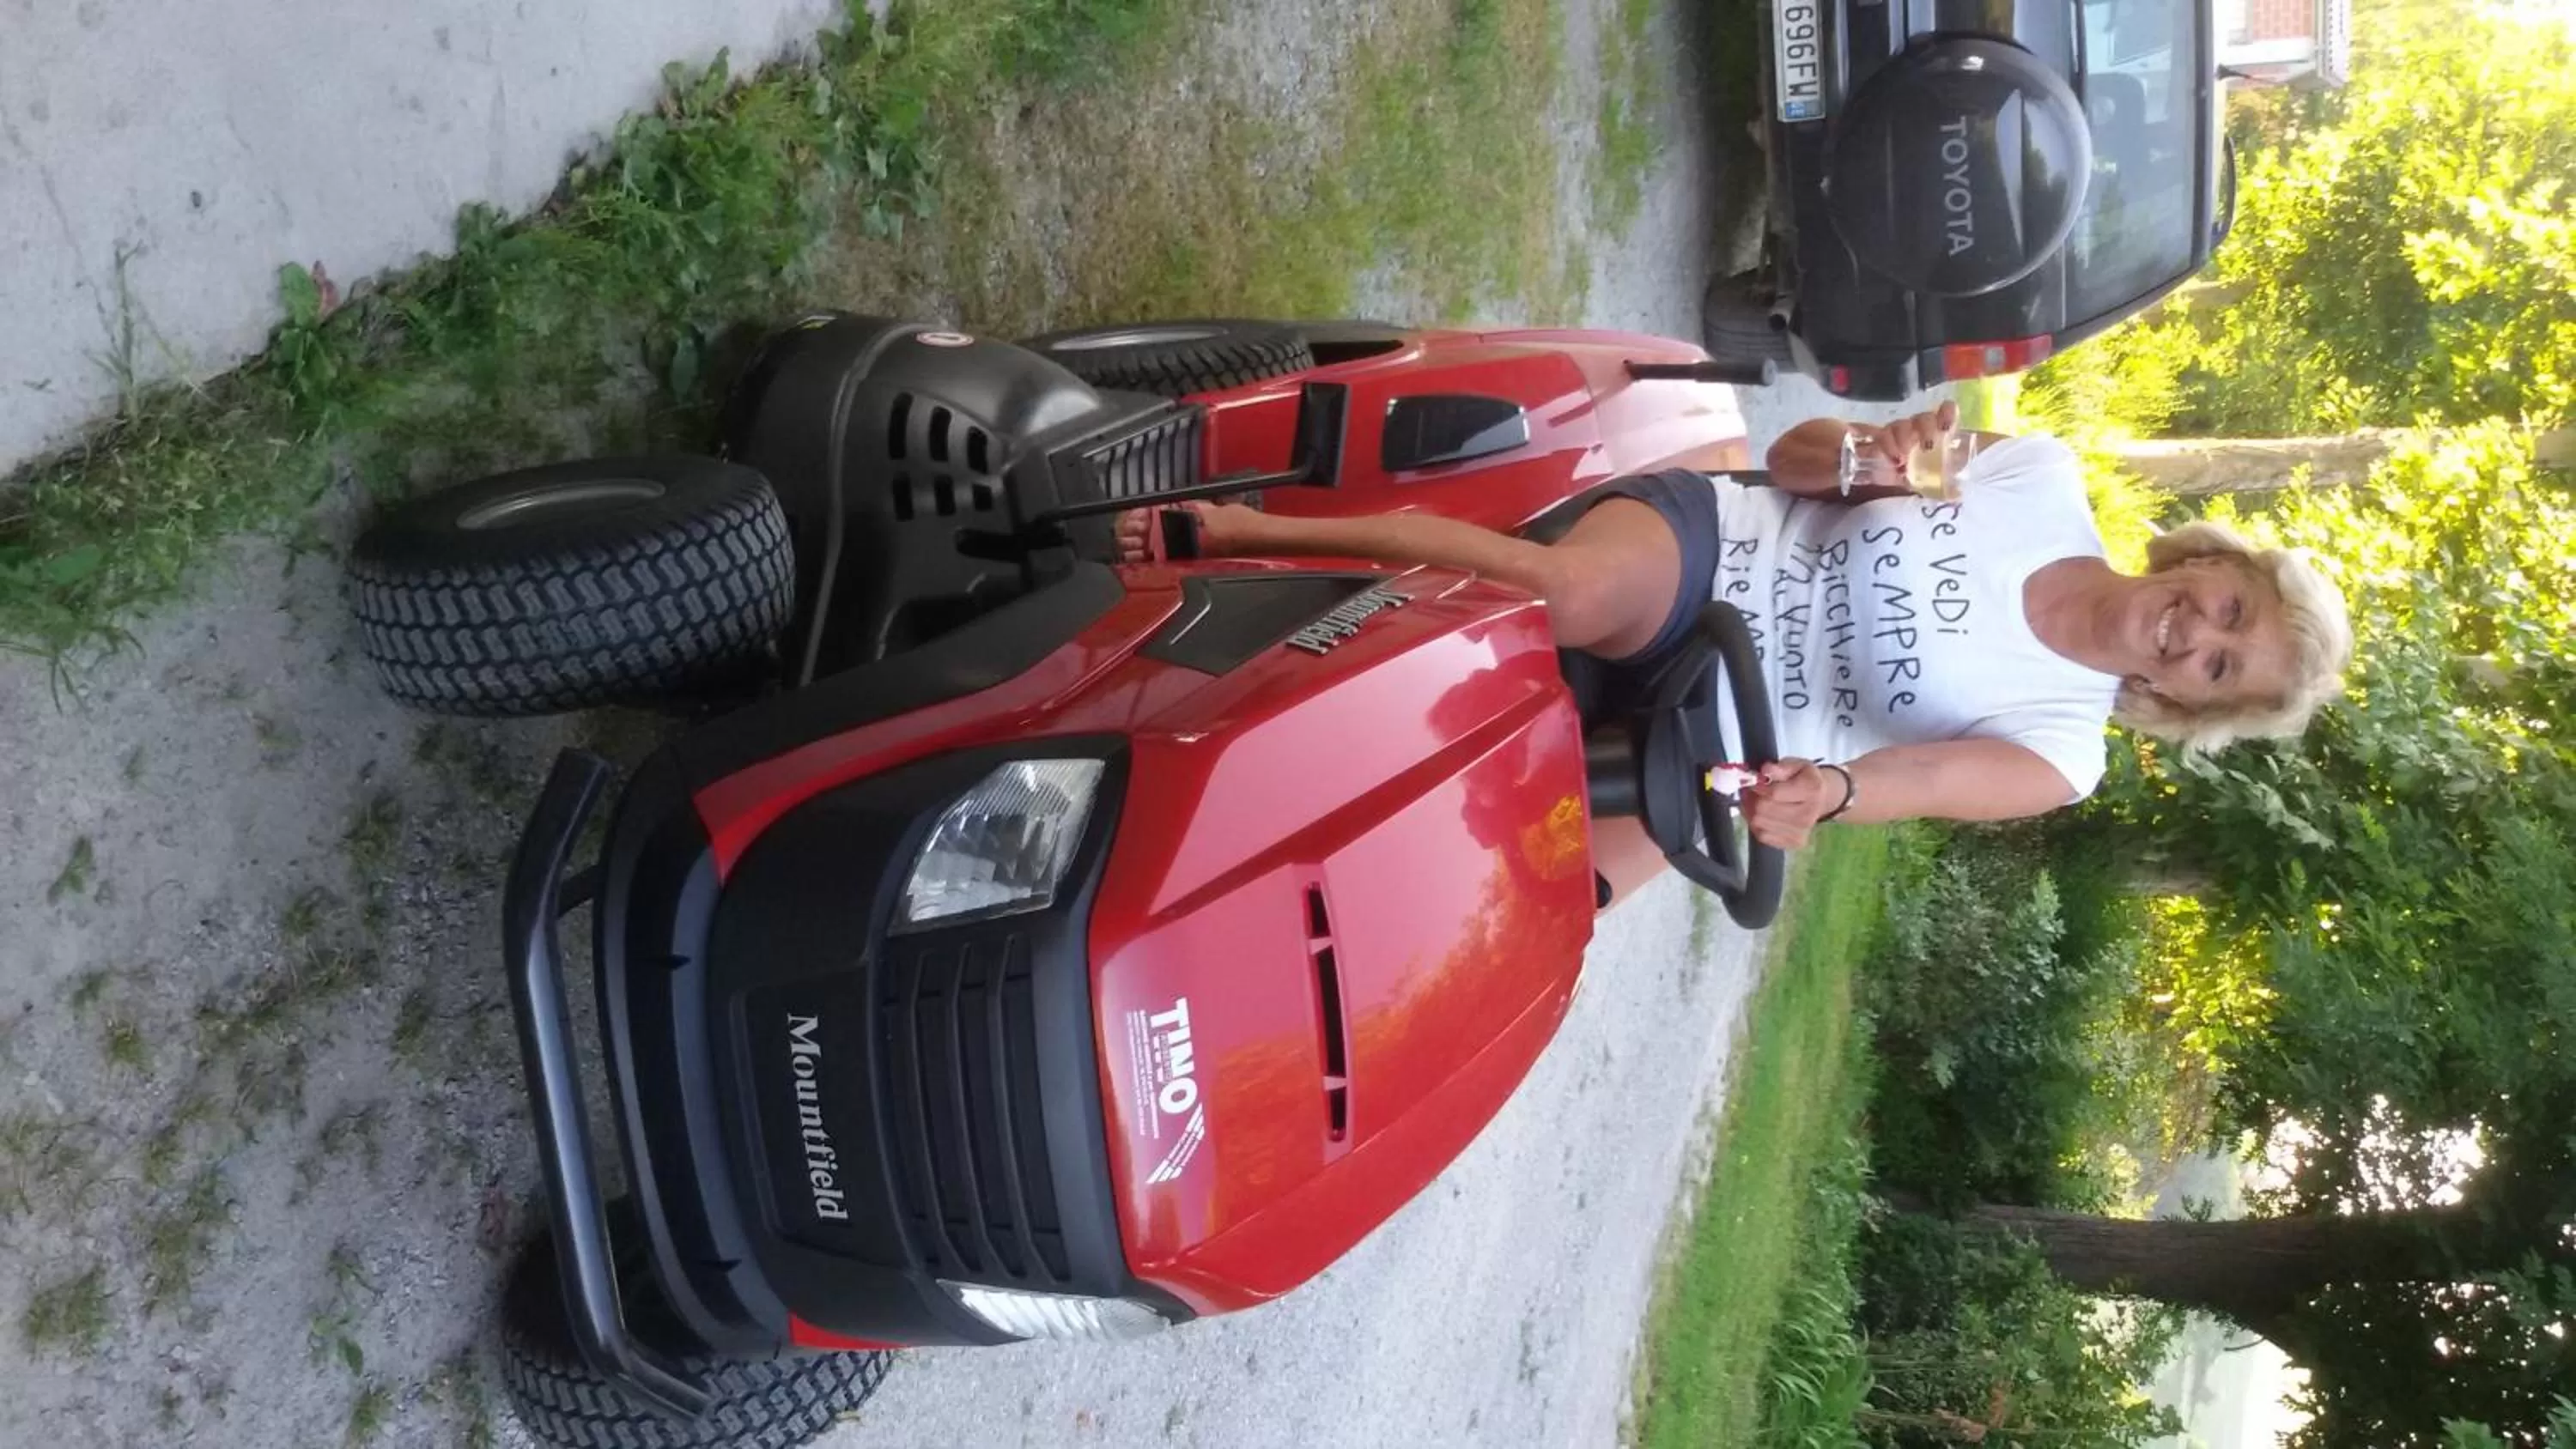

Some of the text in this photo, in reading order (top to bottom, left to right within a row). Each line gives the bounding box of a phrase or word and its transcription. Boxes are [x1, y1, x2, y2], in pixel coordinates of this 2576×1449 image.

[1939, 116, 1974, 256] TOYOTA
[787, 1012, 849, 1220] Mountfield
[1150, 997, 1198, 1114] TINO
